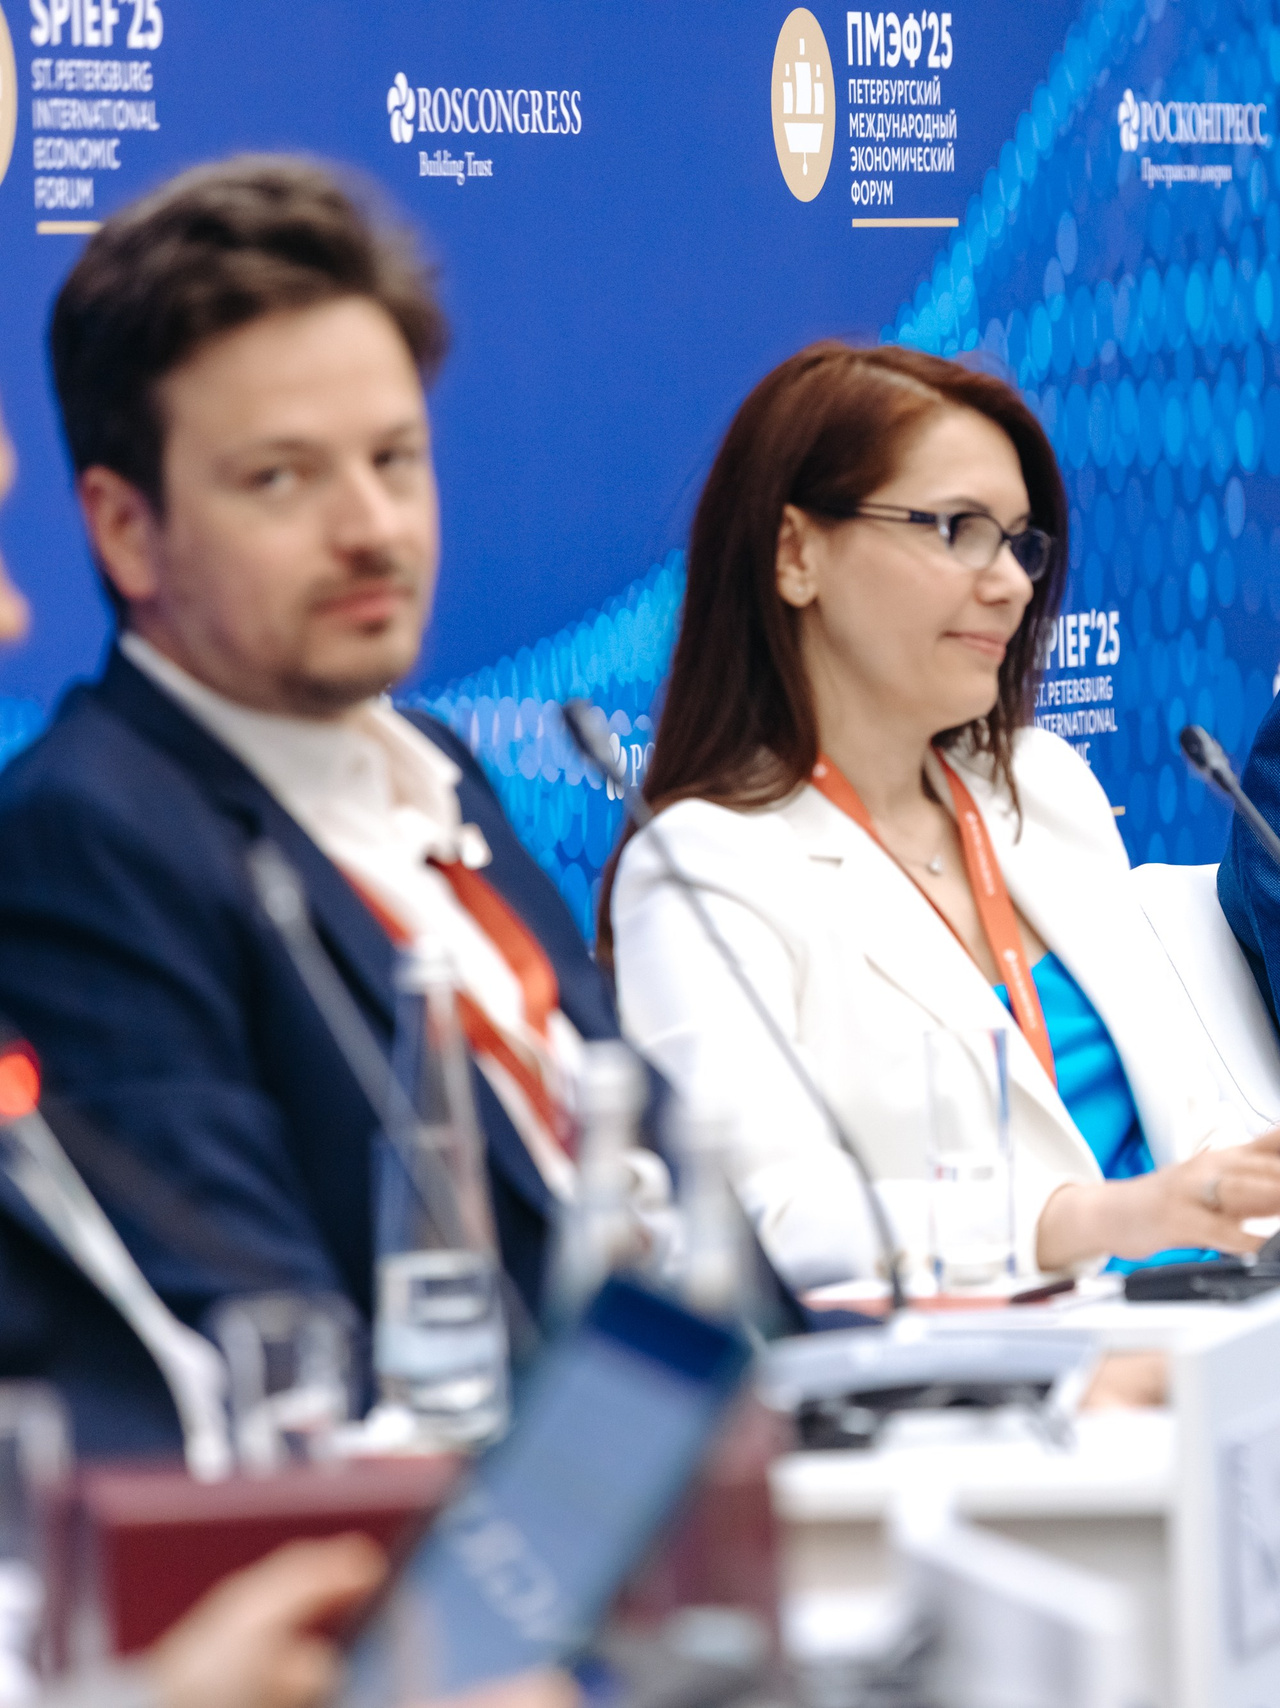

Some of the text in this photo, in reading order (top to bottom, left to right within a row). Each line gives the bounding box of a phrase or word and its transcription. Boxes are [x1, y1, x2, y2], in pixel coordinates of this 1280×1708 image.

[29, 0, 163, 50] SPIEF25
[848, 75, 941, 105] ПЕТЕРБУРГСКИЙ
[32, 98, 160, 131] INTERNATIONAL
[417, 87, 582, 134] ROSCONGRESS
[849, 109, 957, 142] МЕЖДУНАРОДНЫЙ
[1140, 101, 1267, 145] РОСКОНГРЕСС
[33, 137, 121, 170] ECONOMIC
[418, 150, 493, 186] Building Trust
[850, 142, 955, 172] ЭКОНОМИЧЕСКИЙ
[34, 176, 95, 209] FORUM
[851, 180, 894, 205] ФОРУМ
[1048, 675, 1113, 706] PETERSBURG
